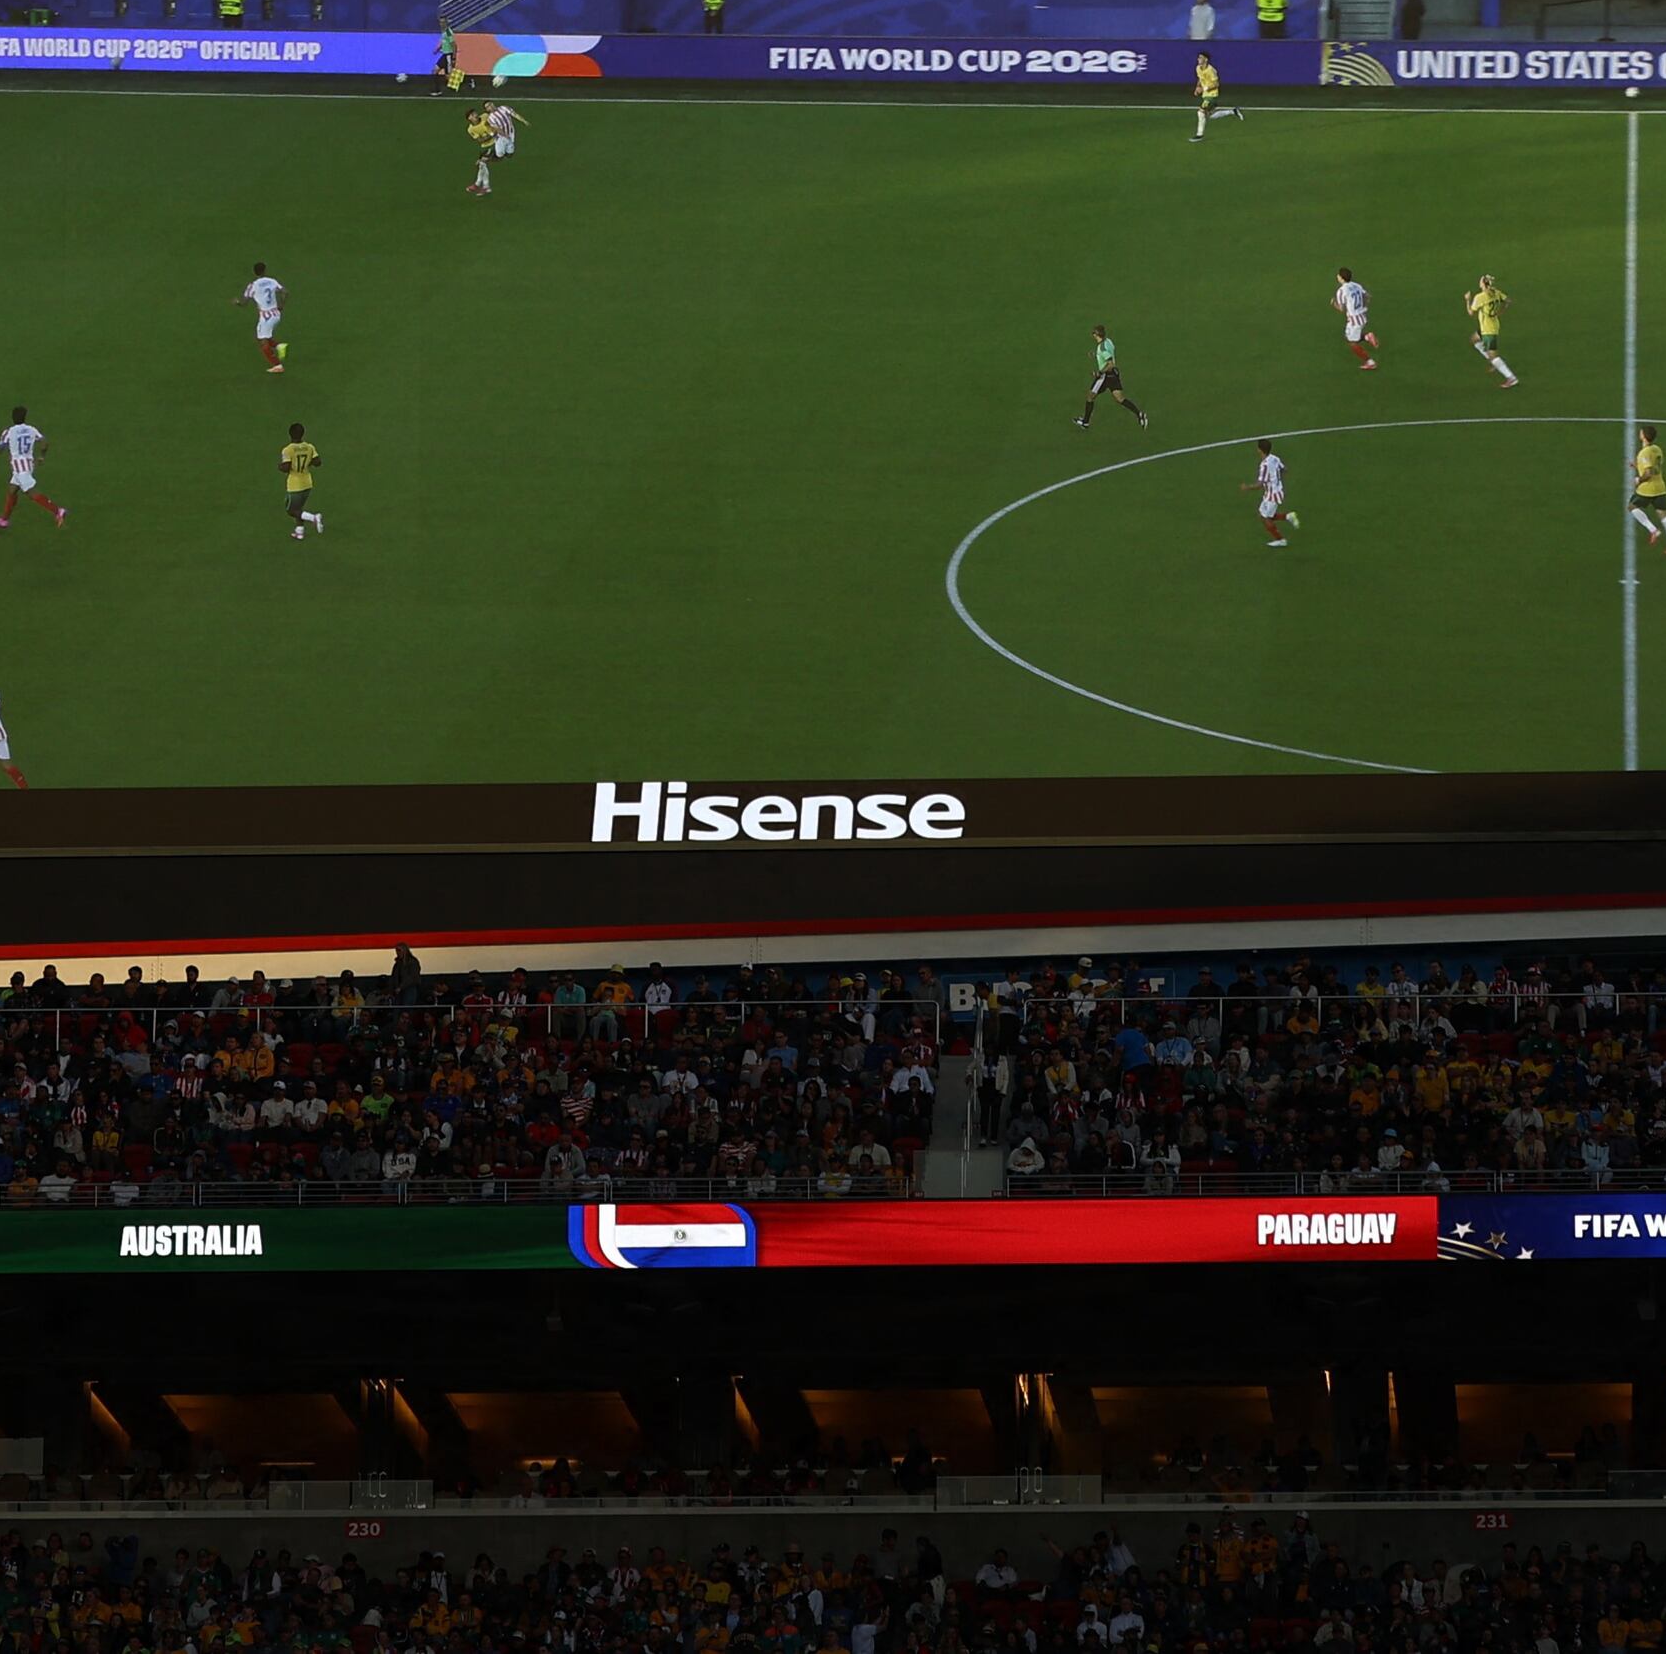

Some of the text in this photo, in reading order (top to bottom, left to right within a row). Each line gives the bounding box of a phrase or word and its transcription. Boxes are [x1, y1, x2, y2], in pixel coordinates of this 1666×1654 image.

[23, 38, 92, 57] WORLD
[93, 39, 132, 58] CUP
[200, 41, 281, 61] OFFICIAL
[283, 42, 322, 61] APP
[769, 48, 836, 70] FIFA
[839, 48, 954, 71] WORLD
[958, 49, 1023, 72] CUP
[1397, 50, 1520, 79] UNITED
[1525, 51, 1653, 80] STATES
[17, 435, 32, 455] 15
[296, 454, 308, 473] 17
[591, 781, 966, 842] Hisense
[1257, 1213, 1396, 1245] PARAGUAY
[1574, 1214, 1641, 1238] FIFA
[119, 1224, 263, 1257] AUSTRALIA
[348, 1522, 381, 1537] 230
[1476, 1514, 1508, 1529] 231
